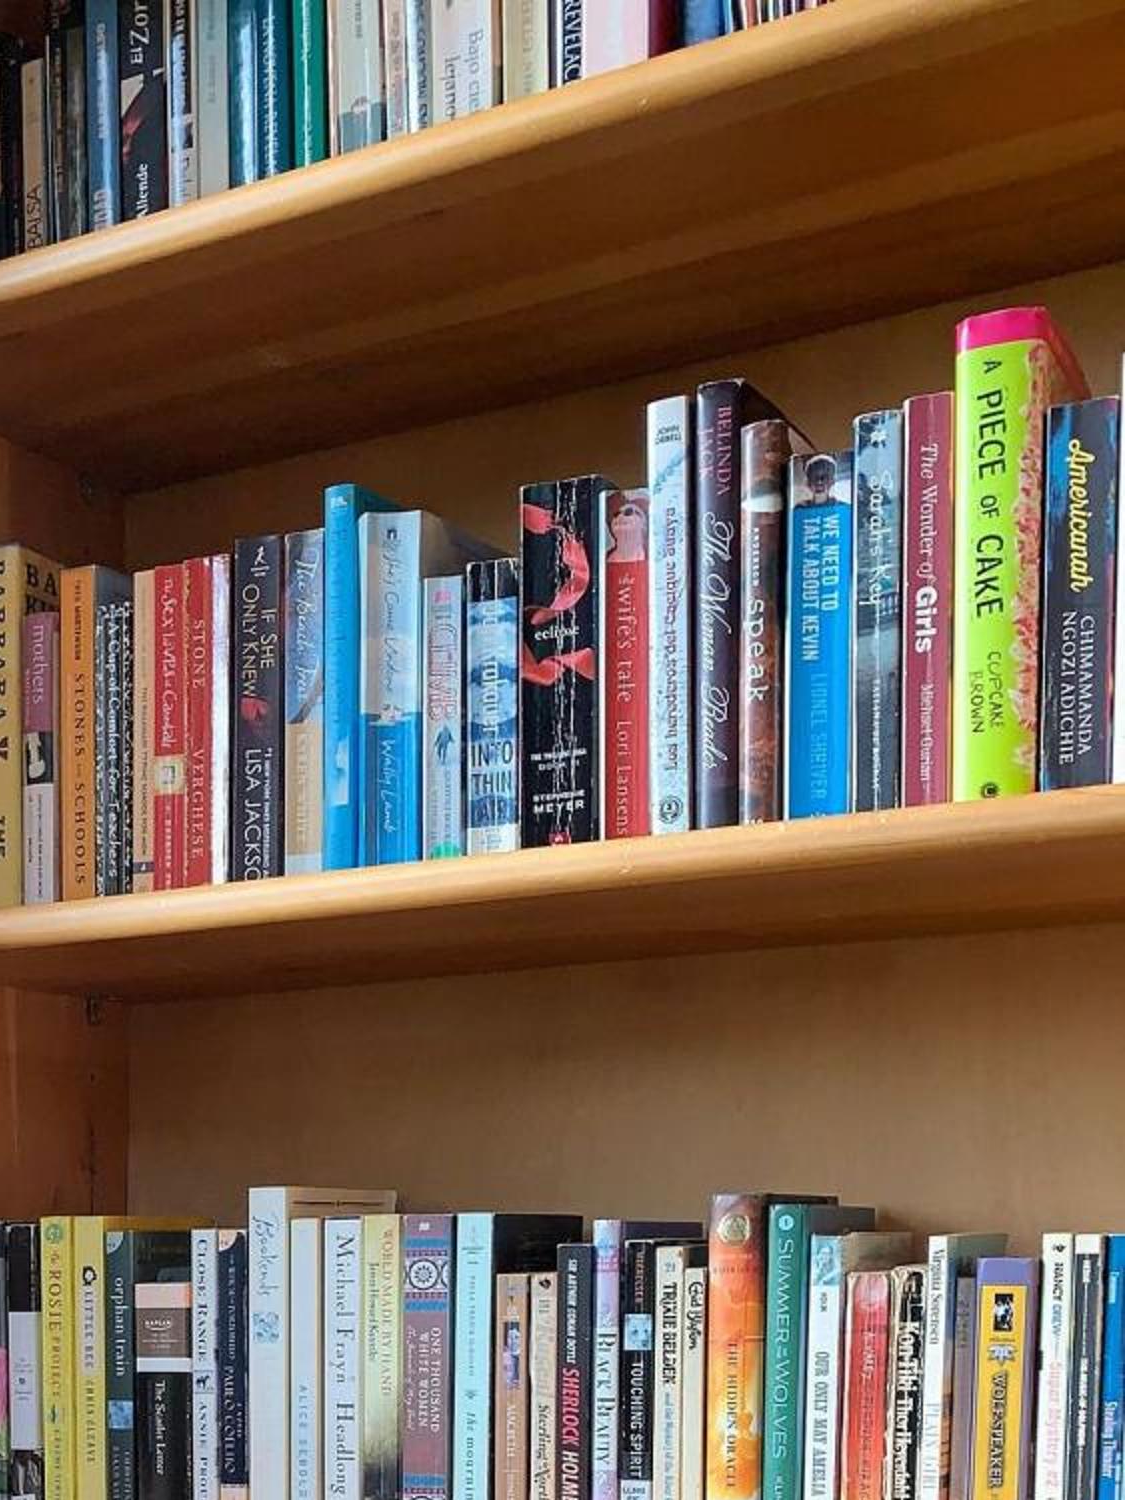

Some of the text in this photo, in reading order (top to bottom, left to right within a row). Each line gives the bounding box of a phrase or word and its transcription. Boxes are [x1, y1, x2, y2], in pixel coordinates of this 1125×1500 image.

[130, 0, 150, 44] Zor
[563, 0, 582, 81] REVELAC
[716, 406, 732, 495] BELINDA
[975, 360, 1006, 619] A PIECE OF CAKE
[915, 443, 939, 653] The Wonder of Girls
[1067, 439, 1095, 592] Americanah
[801, 518, 819, 660] TALK ABOUT KEVIN
[821, 515, 839, 611] WE NEED TO
[32, 624, 47, 704] mothers
[194, 619, 206, 689] STONE
[242, 584, 259, 697] ONLY KNEW
[260, 608, 277, 669] IF SHE
[535, 624, 579, 641] eclipse
[743, 600, 768, 701] speak
[615, 586, 636, 834] wife's tale Lori Lansens
[970, 672, 984, 733] BROWN
[987, 651, 1004, 729] CUPCAKE
[1059, 612, 1076, 765] NGOZI ADICHIE
[1077, 616, 1095, 755] CHIMAMANDA
[74, 673, 86, 884] STONES SCHOOLS
[105, 622, 120, 878] A Cup of Comfort for Teachers
[472, 742, 515, 763] INTO
[473, 771, 515, 795] THIN
[193, 750, 208, 859] VERGHESE
[245, 750, 261, 881] LISA JACKSO
[534, 800, 584, 813] MEYER
[49, 1269, 64, 1331] ROSIE
[84, 1291, 94, 1368] LITTLE BEE
[110, 1278, 128, 1376] orphan train
[197, 1240, 208, 1362] CLOSE RANGE
[382, 1285, 392, 1326] MADE
[661, 1283, 677, 1385] TRIXIE BELDEN
[930, 1249, 945, 1345] Virginia Sorensen
[1052, 1263, 1064, 1338] NANCY DREW
[330, 1236, 355, 1496] Michael Frayn Headlong
[418, 1333, 429, 1427] WHITE WOMEN
[430, 1328, 441, 1432] ONE THOUSAND
[630, 1360, 645, 1429] TOUCHING
[727, 1343, 738, 1429] THE HIDDEN
[772, 1238, 794, 1458] SUMMER WOLVES
[897, 1321, 922, 1428] Kon-Tiki Thor
[155, 1381, 166, 1475] The Letter
[223, 1366, 235, 1473] PAULO COELHO
[299, 1384, 308, 1430] ALICE
[466, 1411, 477, 1433] the
[536, 1404, 550, 1459] Sterling
[562, 1367, 581, 1447] SHERLOCK
[596, 1332, 617, 1465] BLACK BEAUTY
[811, 1351, 830, 1496] OUR ONLY MAY AMELIA
[1101, 1401, 1117, 1478] Stealing Thunder
[629, 1433, 643, 1478] SPIRIT
